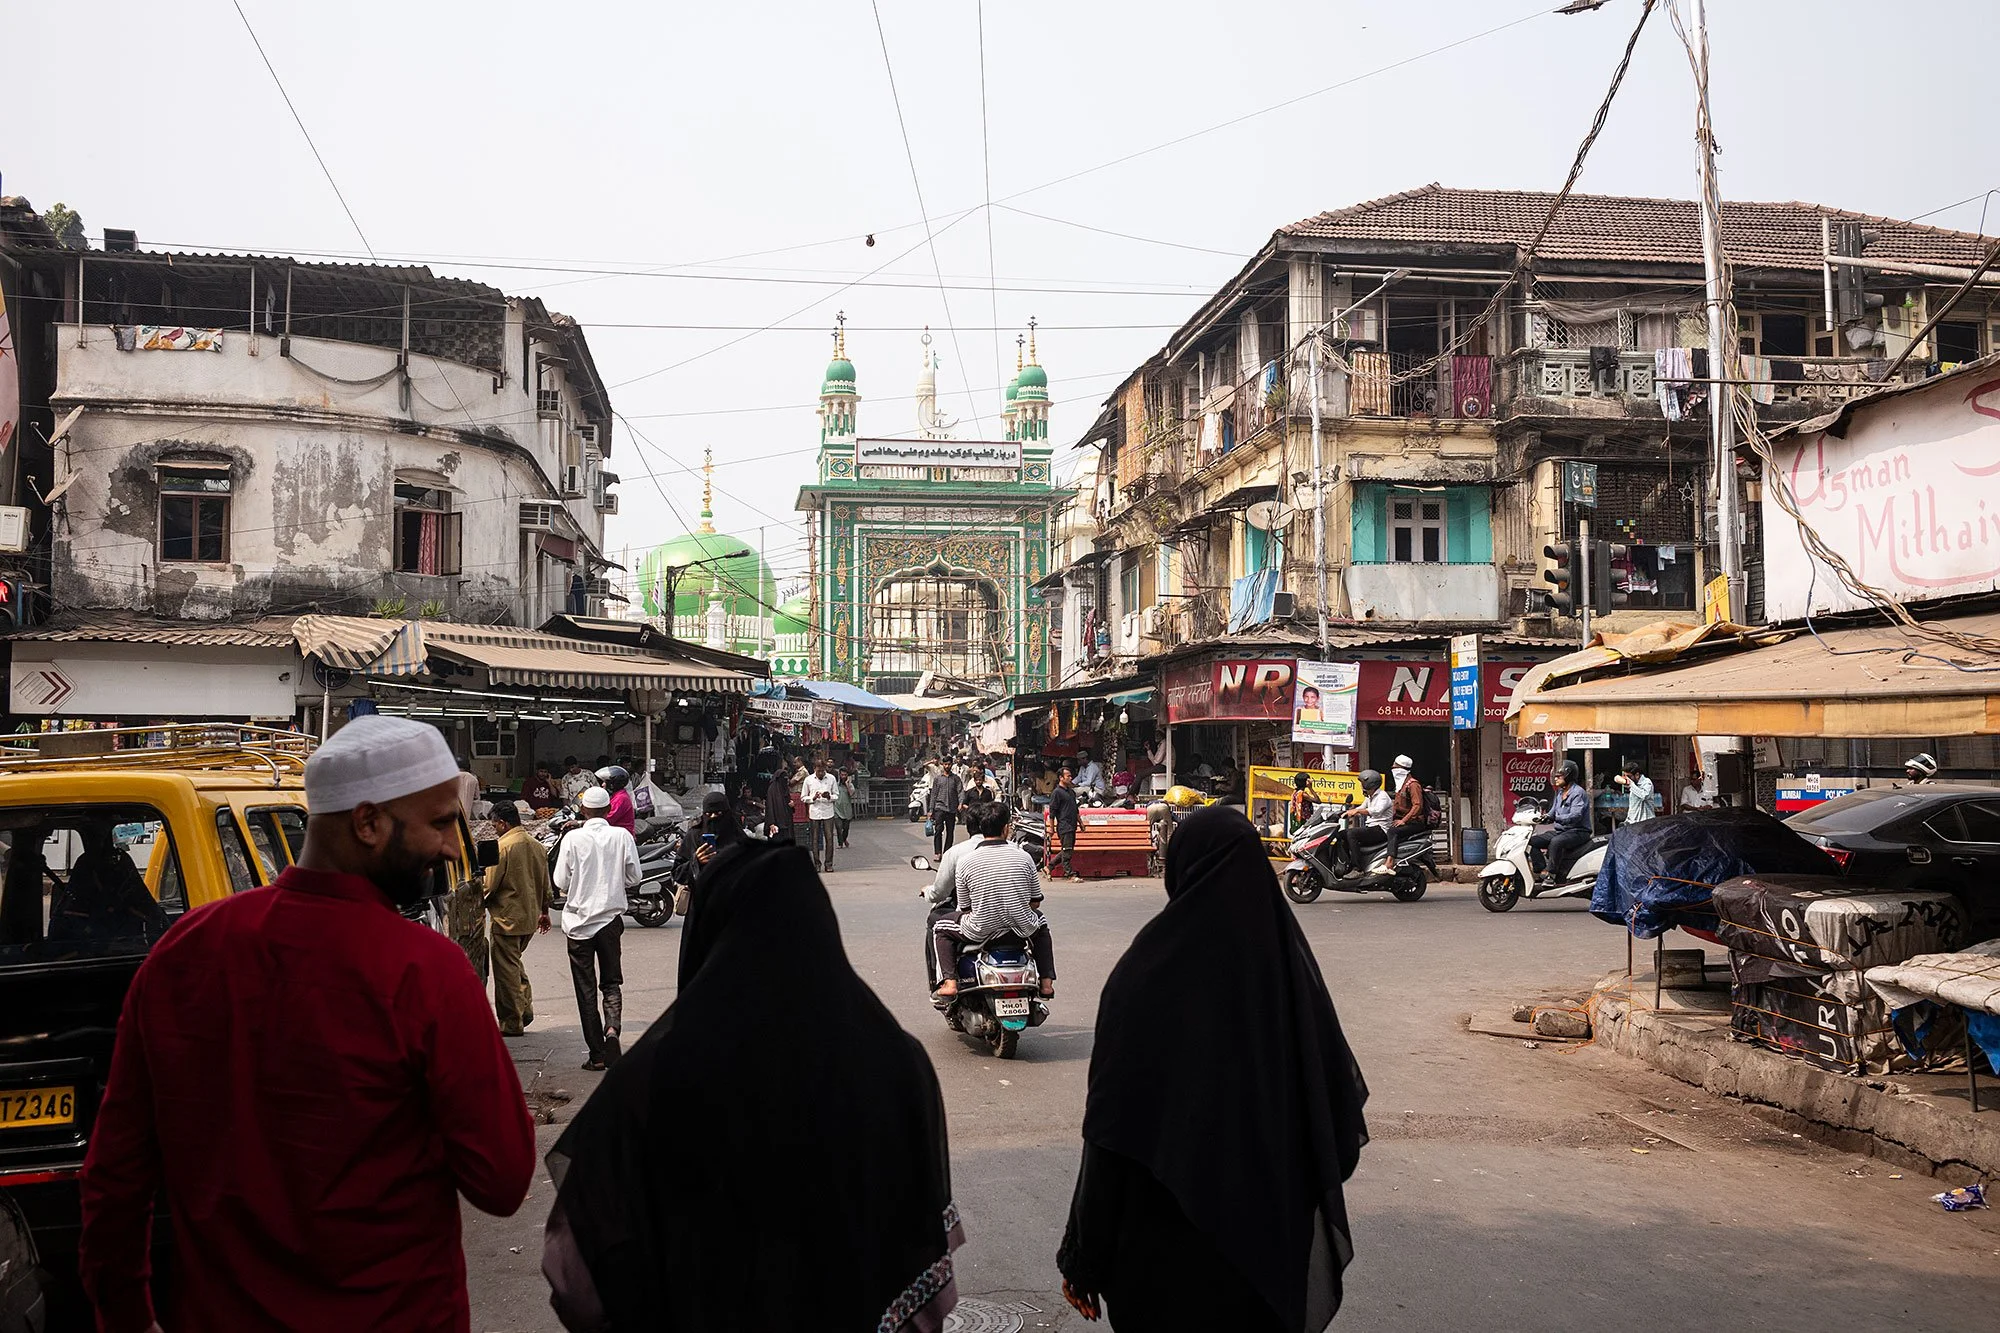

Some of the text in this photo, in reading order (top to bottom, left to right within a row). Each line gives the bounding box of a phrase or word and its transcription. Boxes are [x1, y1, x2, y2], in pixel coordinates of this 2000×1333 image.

[1790, 431, 1911, 512] Usman
[761, 701, 809, 712] IRFAN FLORIST
[1377, 706, 1406, 716] 68-H.
[1508, 782, 1546, 792] JAGAO
[1781, 790, 1801, 799] MUMBAI
